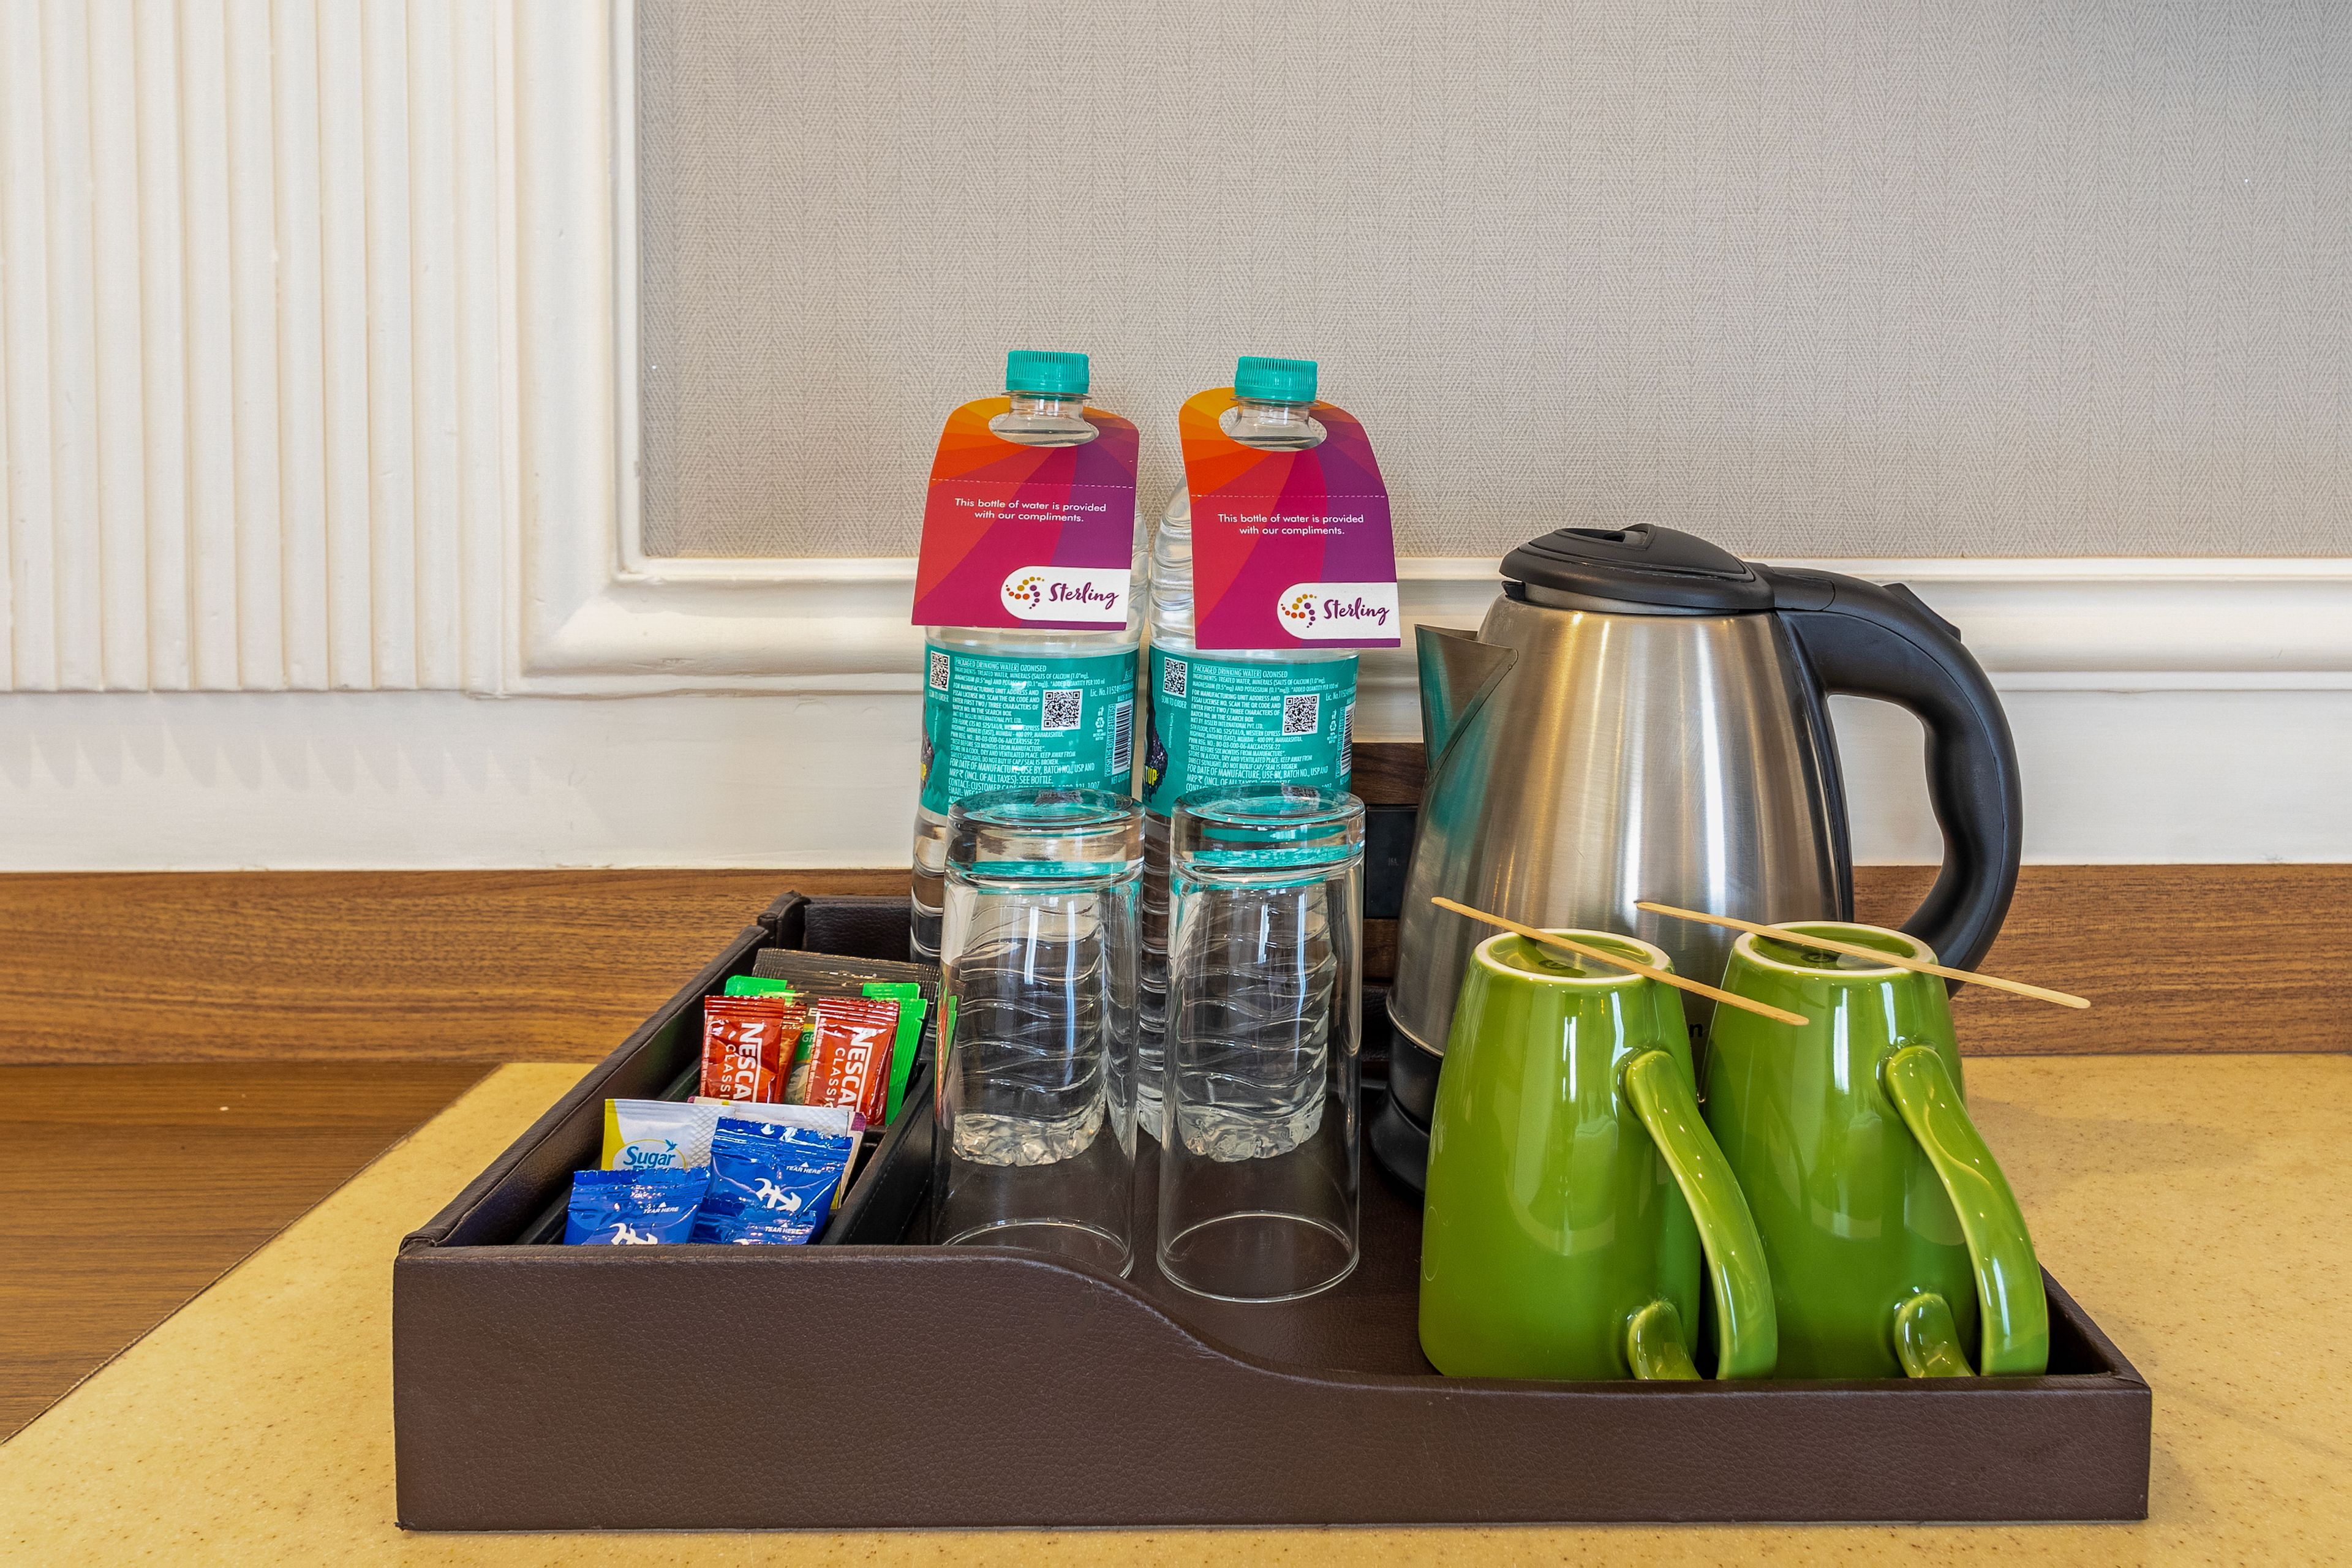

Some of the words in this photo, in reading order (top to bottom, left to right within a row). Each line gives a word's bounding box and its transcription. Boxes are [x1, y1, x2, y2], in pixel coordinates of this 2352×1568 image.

[955, 498, 974, 507] This
[978, 499, 1005, 508] bottle
[1008, 500, 1020, 508] of
[1052, 502, 1060, 510] is
[1063, 502, 1106, 513] provided
[974, 510, 995, 519] with
[1018, 513, 1084, 522] compliments.
[1218, 514, 1237, 522] This
[1240, 514, 1267, 523] bottle
[1270, 514, 1280, 522] of
[1312, 514, 1319, 523] is
[1322, 514, 1364, 526] provided
[1240, 526, 1259, 535] with
[1281, 526, 1345, 537] compliments.
[1049, 582, 1120, 610] Sterling
[1324, 597, 1390, 626] Sterling
[1194, 665, 1216, 674] PACKAGED
[1218, 668, 1242, 676] DRINKING
[1200, 690, 1236, 699] MANUFACTURING
[949, 758, 958, 767] FOR
[959, 759, 970, 769] DATE
[971, 761, 978, 770] OF
[1022, 766, 1033, 774] USE
[1044, 766, 1060, 774] BATCH
[1074, 764, 1085, 772] USP
[1085, 763, 1095, 771] AND
[1188, 764, 1196, 773] FOR
[1197, 765, 1210, 775] DATE
[1210, 767, 1218, 776] OF
[1218, 767, 1261, 779] MANUFACTURE,
[1283, 769, 1298, 778] BATCH
[1311, 767, 1320, 776] USP
[948, 777, 970, 789] CONTACT:
[980, 772, 986, 782] OF
[987, 774, 997, 783] ALL
[1019, 775, 1030, 784] SEE
[1031, 775, 1054, 785] BOTTLE.
[733, 1022, 765, 1102] NESCA
[837, 1027, 875, 1112] NESCA
[720, 1044, 736, 1098] CLASSI
[623, 1145, 676, 1168] Sugar
